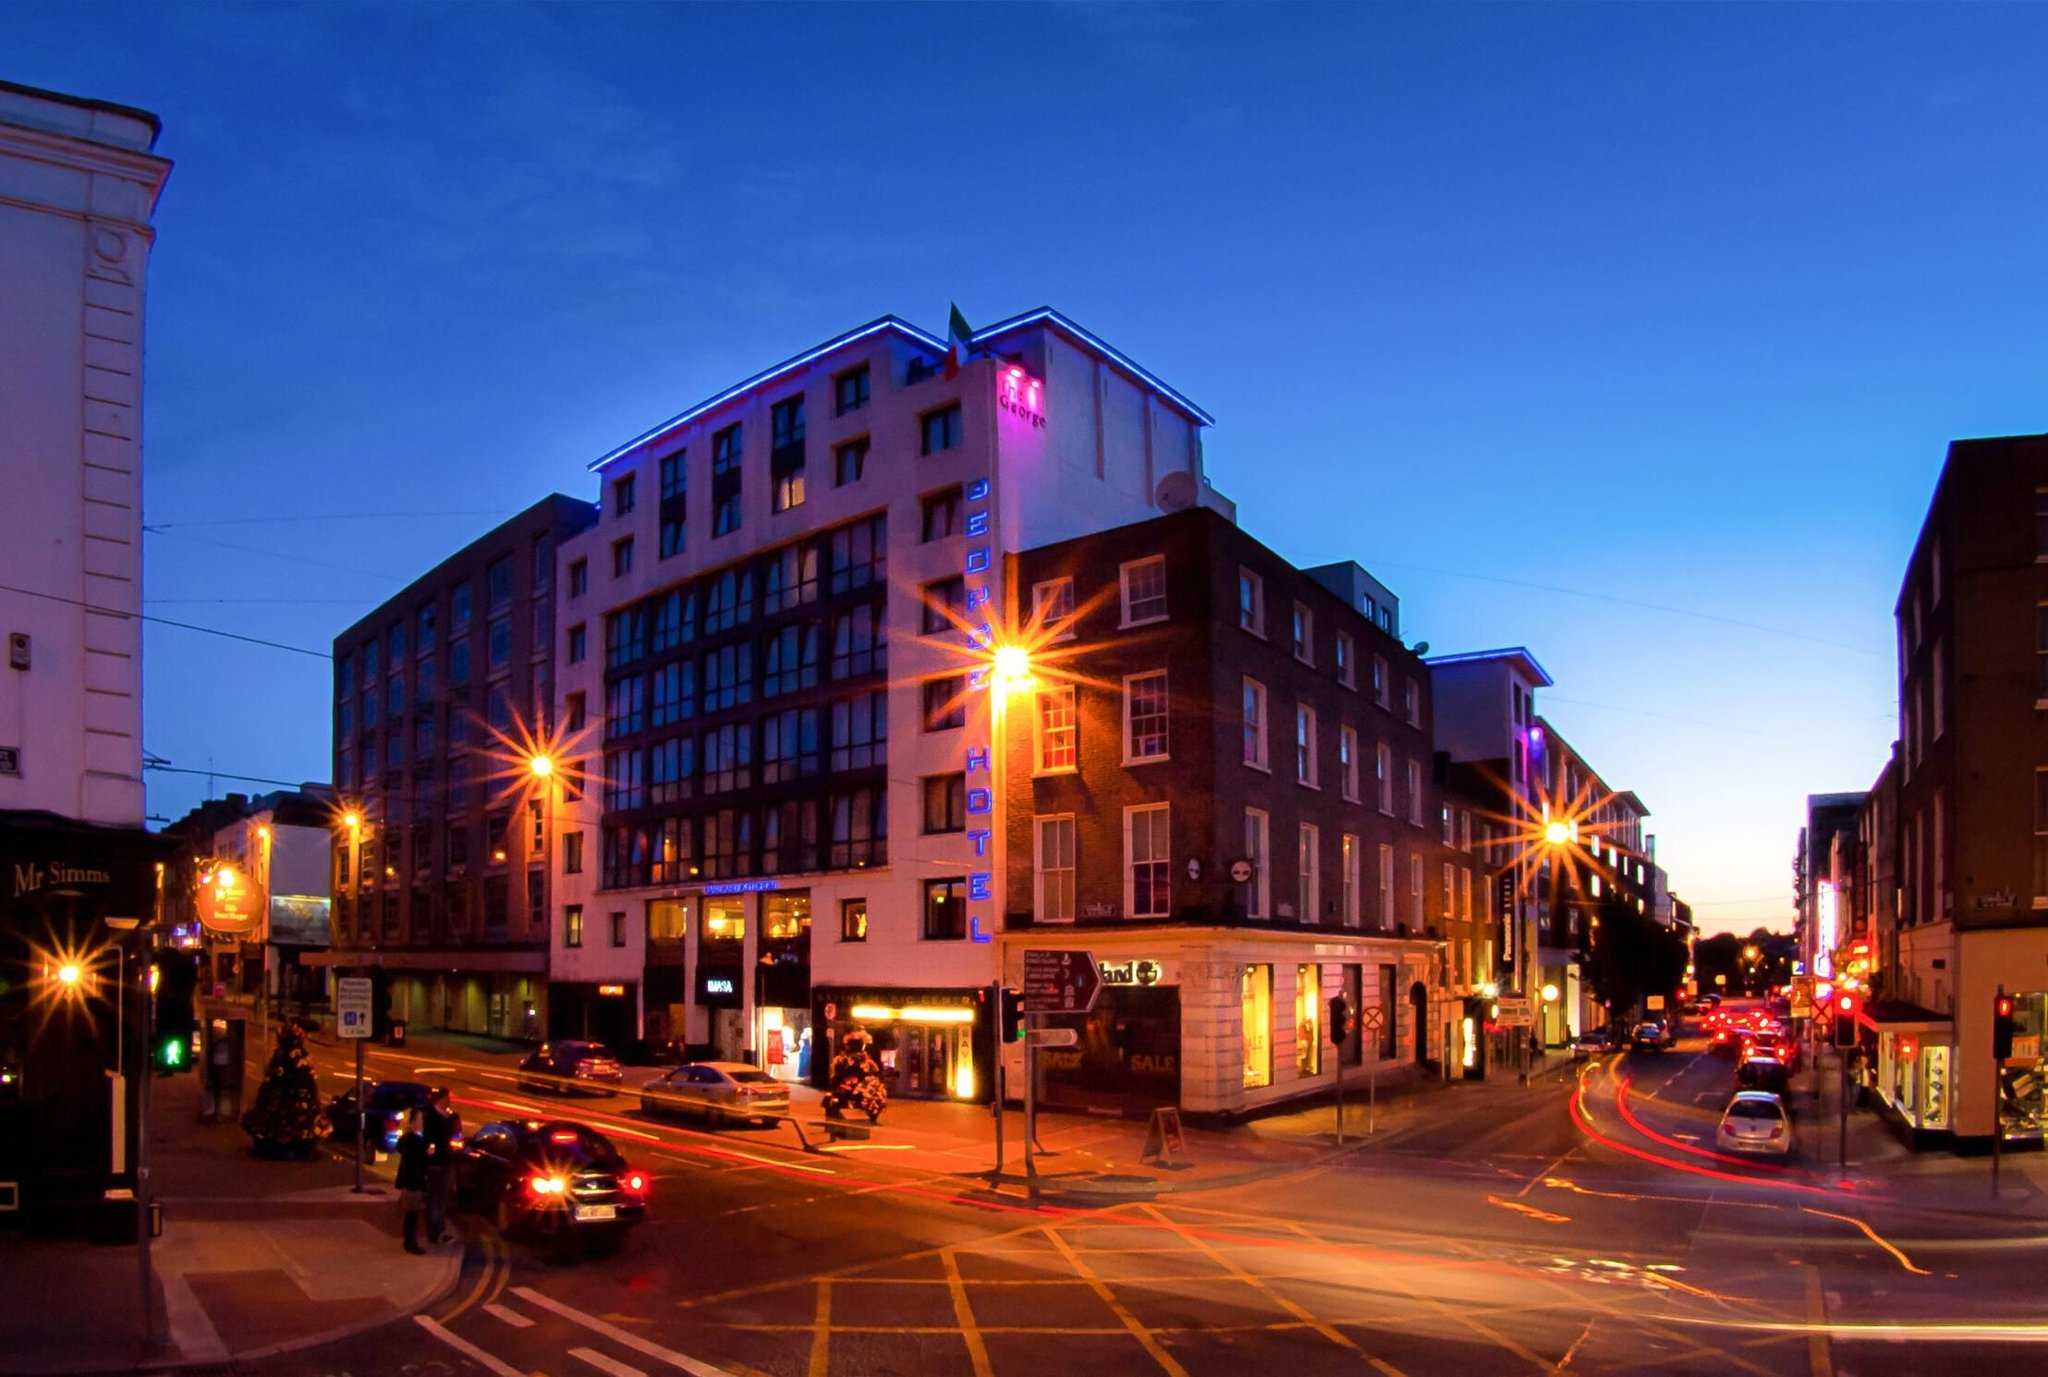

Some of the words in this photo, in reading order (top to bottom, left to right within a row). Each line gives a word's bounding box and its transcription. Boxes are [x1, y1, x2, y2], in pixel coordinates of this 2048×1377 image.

[1000, 395, 1046, 428] George
[966, 747, 993, 944] HOTEL
[14, 861, 44, 897] Mr
[49, 860, 111, 885] Simms
[1131, 1055, 1175, 1072] SALE
